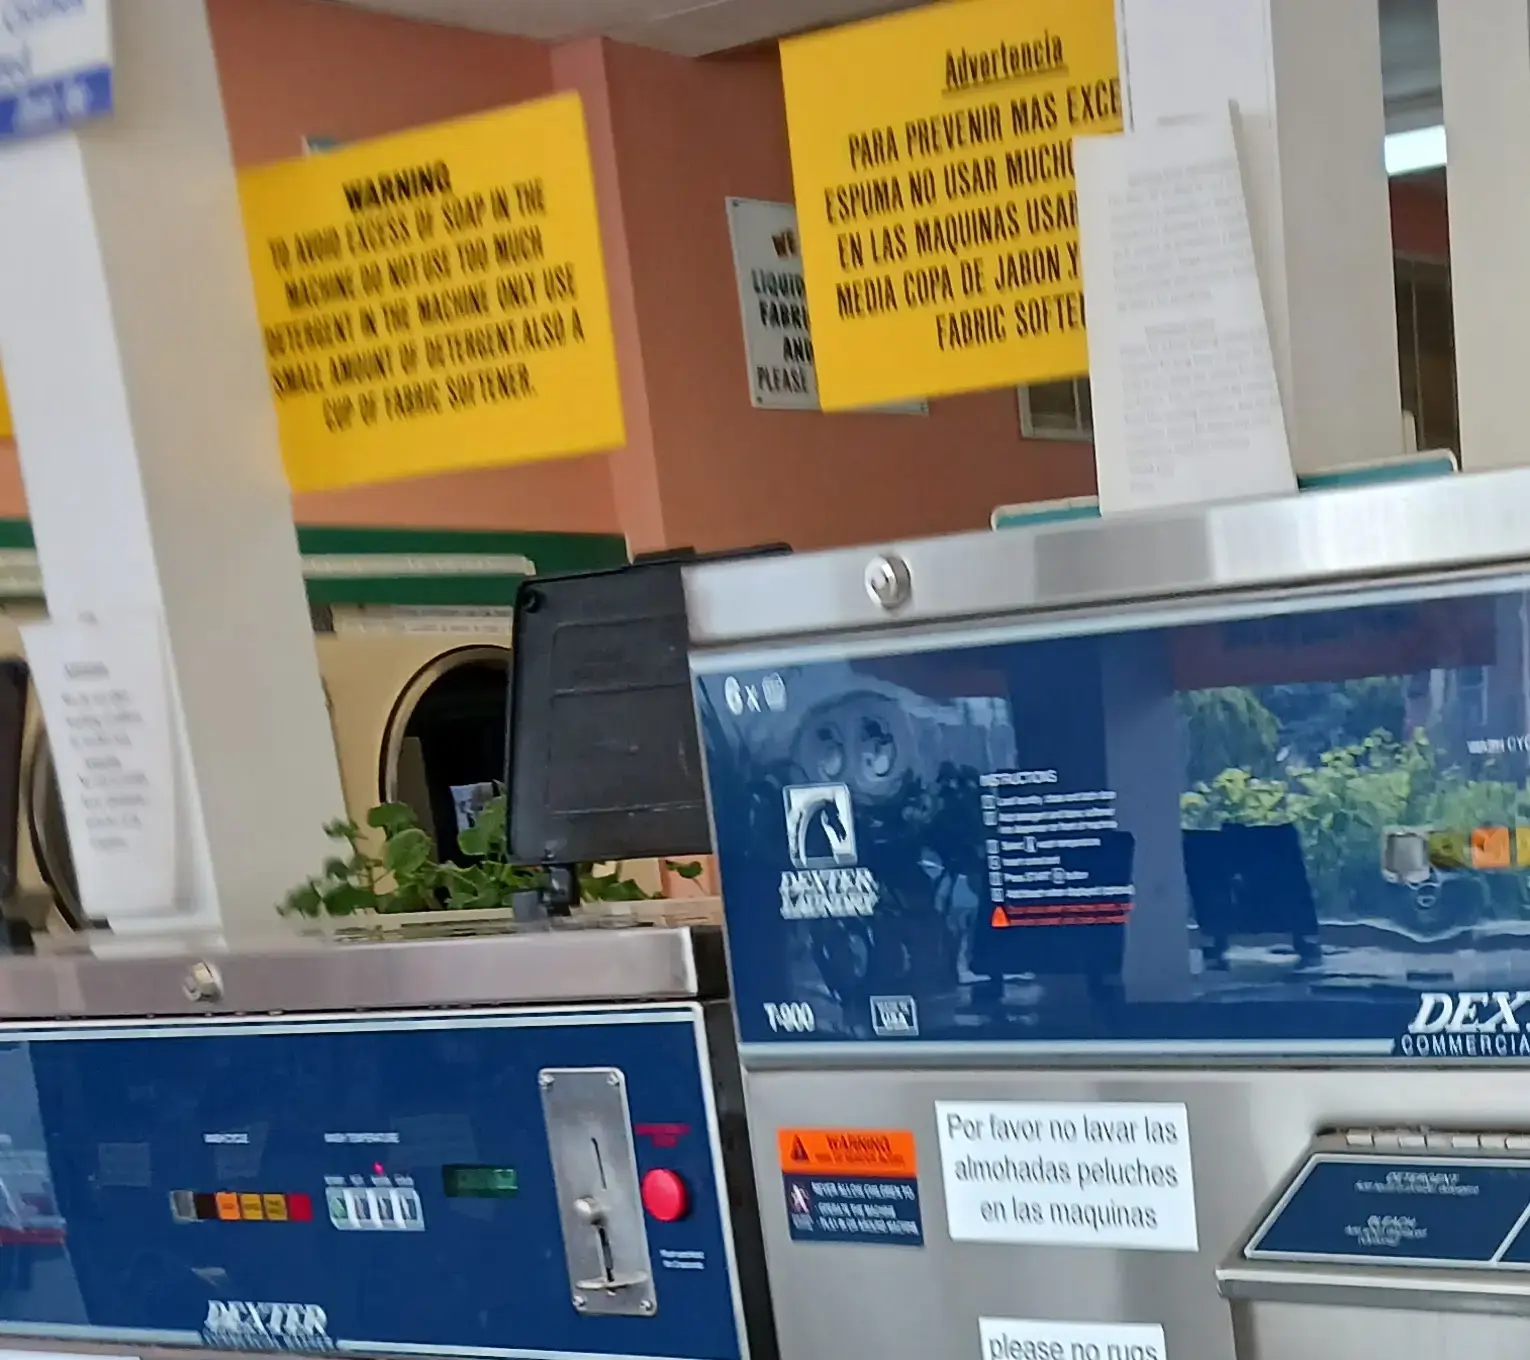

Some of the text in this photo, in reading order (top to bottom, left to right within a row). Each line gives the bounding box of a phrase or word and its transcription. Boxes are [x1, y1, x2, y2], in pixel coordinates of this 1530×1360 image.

[944, 28, 1063, 92] Advertencia
[848, 126, 899, 173] PARA
[905, 102, 1003, 161] PREVENIR
[1010, 92, 1057, 137] MAS
[342, 161, 451, 212] WARNING
[441, 192, 487, 236] SOAP
[490, 186, 510, 222] IN
[512, 176, 546, 217] THE
[824, 175, 904, 225] ESPUMA
[908, 167, 936, 211] NO
[943, 156, 997, 200] USAR
[492, 224, 544, 270] MUCH
[837, 231, 864, 272] EN
[870, 223, 907, 264] LAS
[914, 201, 1020, 256] MAQUINAS
[358, 304, 379, 338] IN
[380, 298, 412, 336] THE
[416, 279, 489, 327] MACHINE
[496, 271, 537, 312] ONLY
[542, 261, 577, 302] USE
[835, 240, 1079, 321] MEDIA COPA DE JABON Y
[571, 305, 587, 344] A
[935, 304, 1007, 352] FABRIC
[757, 366, 809, 394] PLEASE
[947, 1113, 1178, 1145] Por favor no lavar las
[954, 1155, 1178, 1190] almohadas peluches
[980, 1196, 1158, 1232] en las maquinas
